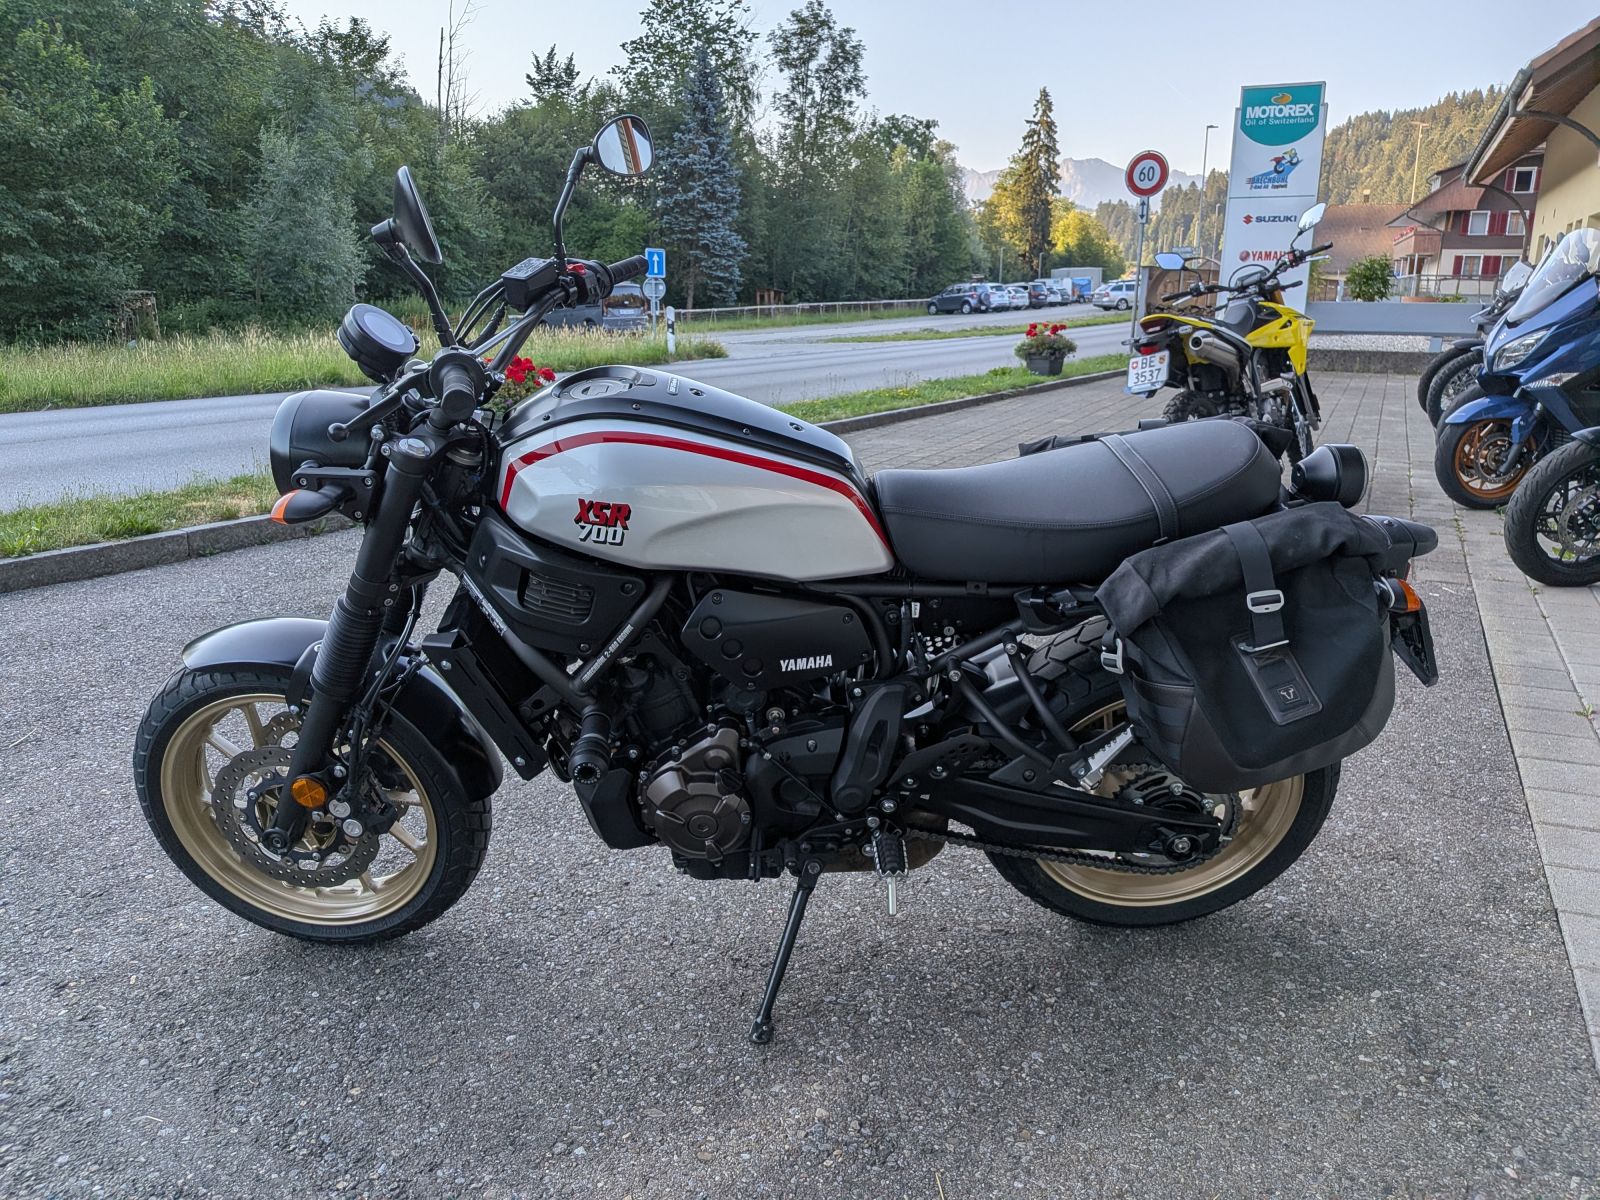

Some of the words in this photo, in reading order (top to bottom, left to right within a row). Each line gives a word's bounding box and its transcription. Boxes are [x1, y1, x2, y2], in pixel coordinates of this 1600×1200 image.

[1246, 104, 1314, 119] MOTOREX
[1269, 117, 1314, 125] Switzerland
[1138, 166, 1155, 182] 60
[1255, 215, 1297, 223] SUZUKI
[1141, 356, 1156, 369] BE
[1133, 368, 1161, 385] 3537
[574, 498, 632, 530] XSR
[579, 522, 625, 546] 700
[780, 654, 832, 672] YAMAHA
